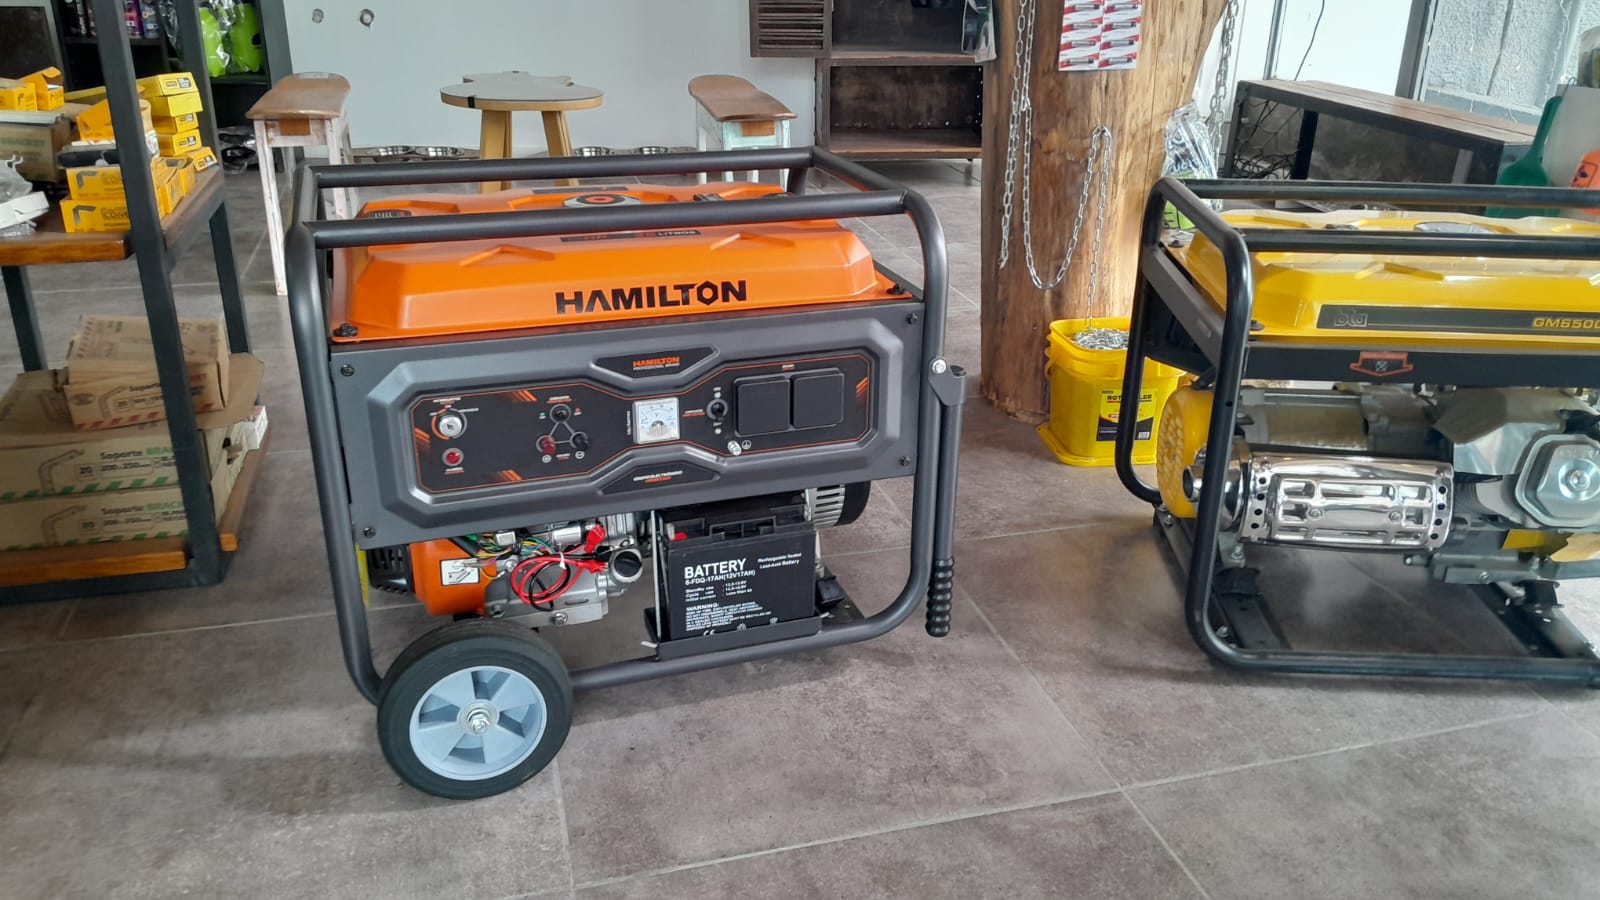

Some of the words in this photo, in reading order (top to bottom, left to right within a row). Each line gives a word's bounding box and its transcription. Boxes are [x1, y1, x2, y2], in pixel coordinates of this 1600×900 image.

[555, 280, 747, 315] HAMILTON
[632, 356, 681, 368] HAMILTON
[100, 450, 143, 460] Soporte
[684, 557, 747, 579] BATTERY
[782, 559, 800, 567] Battery
